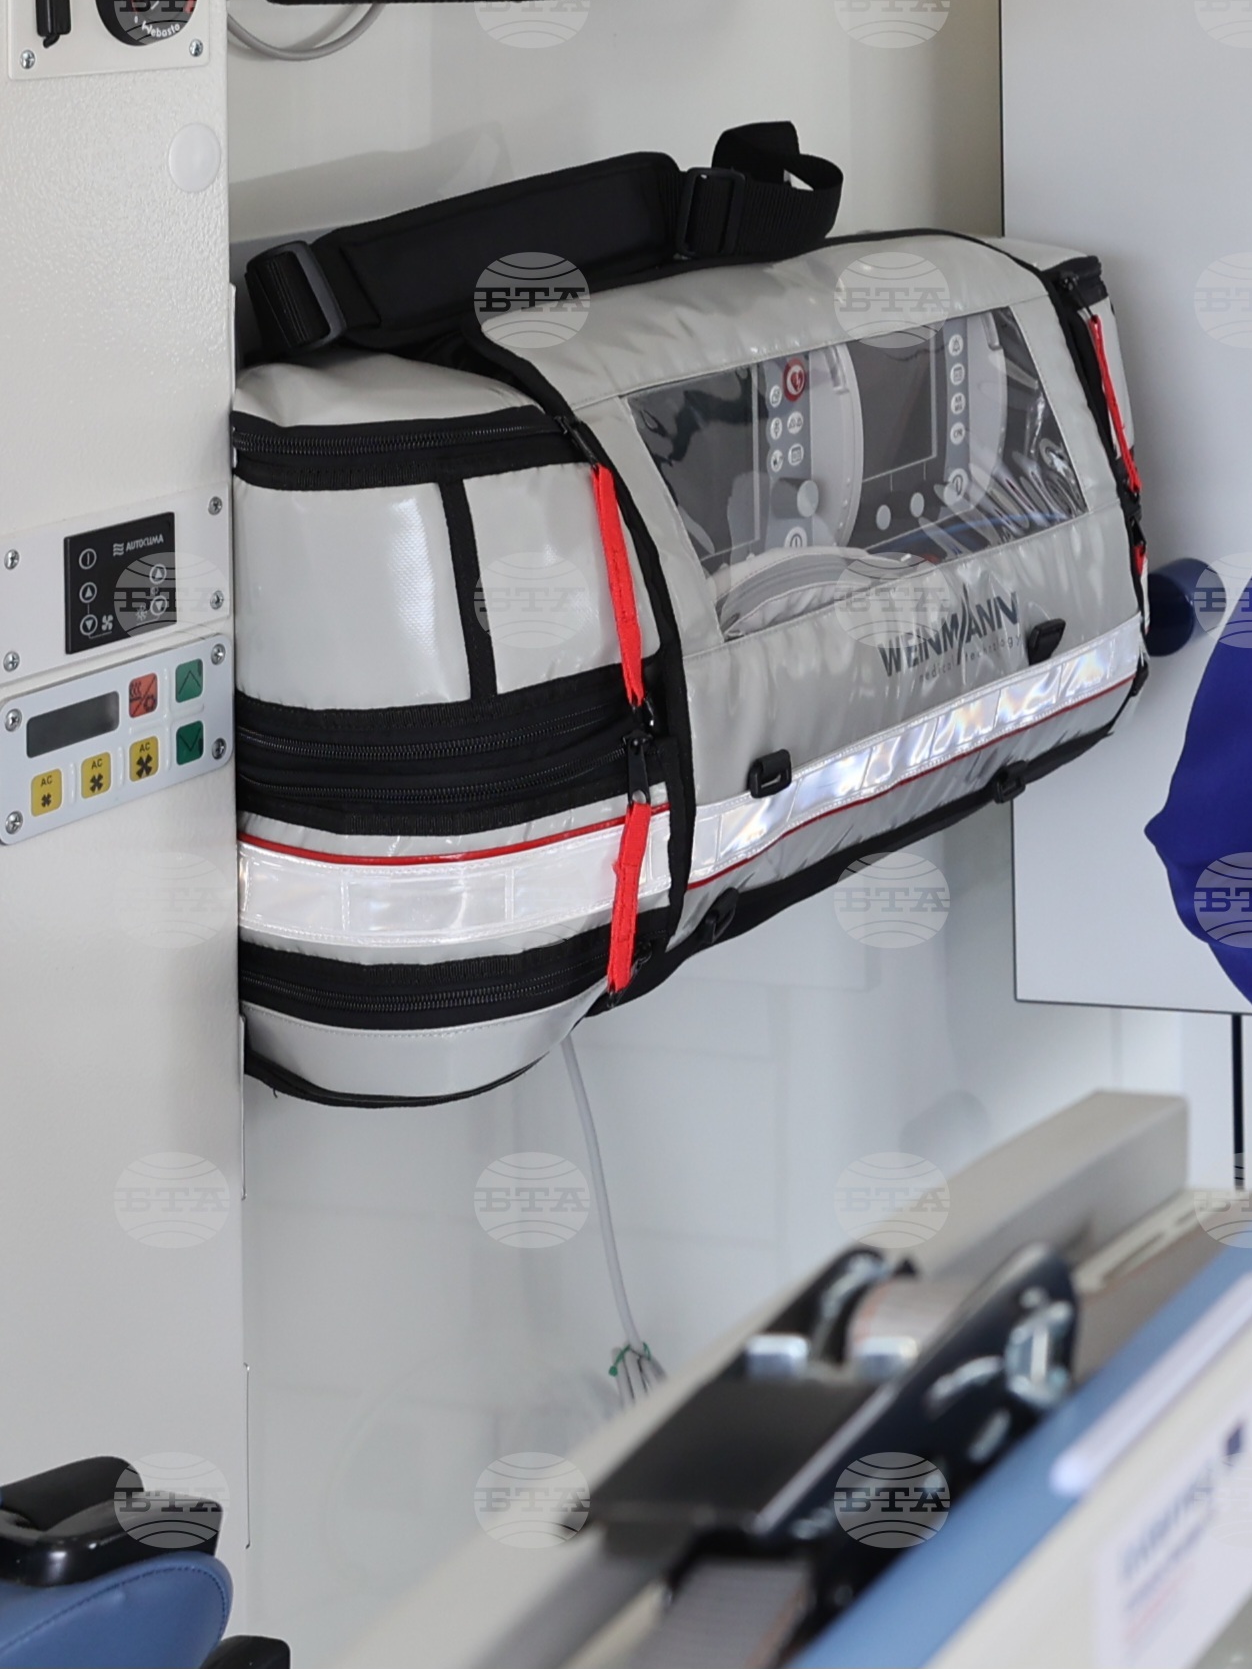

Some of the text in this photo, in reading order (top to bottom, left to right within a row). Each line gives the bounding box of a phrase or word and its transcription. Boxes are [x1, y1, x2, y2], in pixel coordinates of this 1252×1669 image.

[142, 20, 181, 38] Webasto
[877, 583, 1019, 678] WEINMANN
[139, 741, 151, 753] AC
[91, 758, 103, 770] AC
[40, 775, 53, 787] AC
